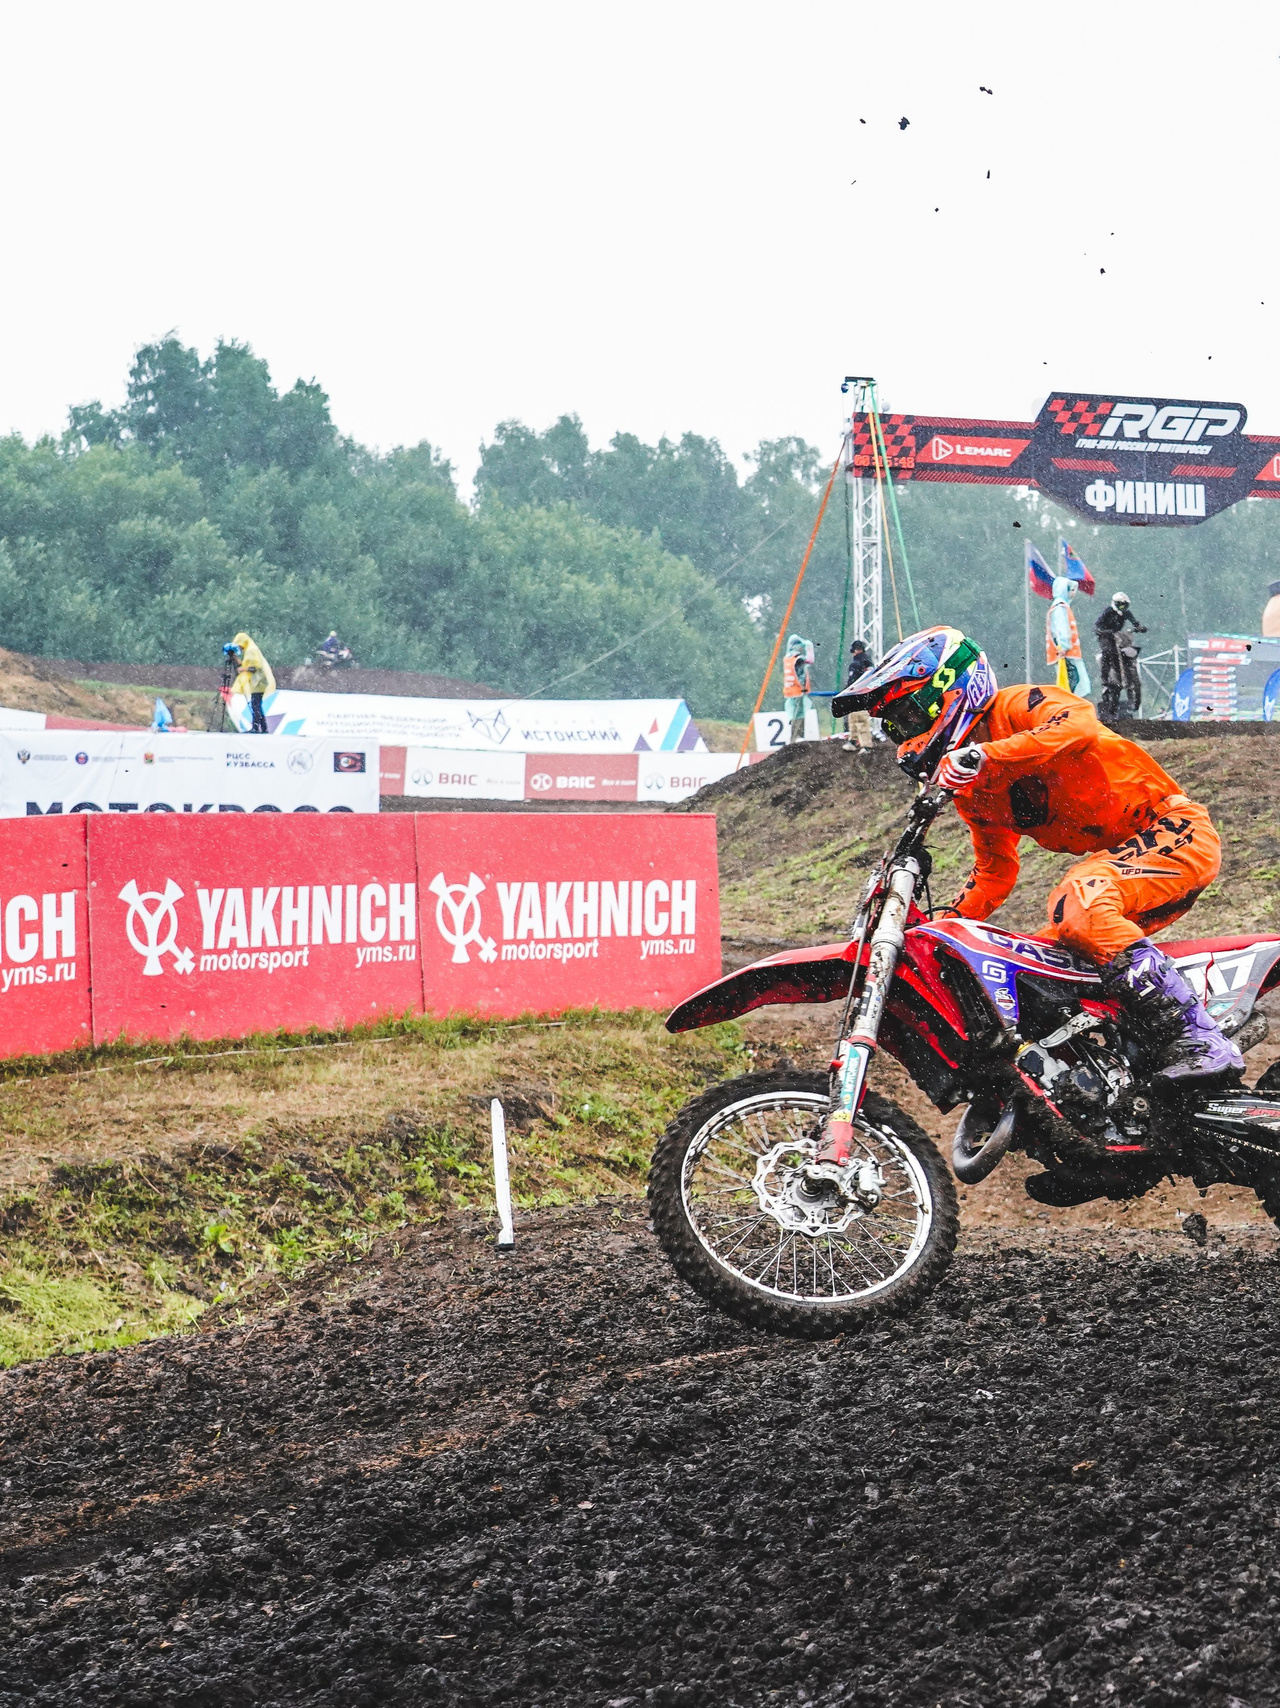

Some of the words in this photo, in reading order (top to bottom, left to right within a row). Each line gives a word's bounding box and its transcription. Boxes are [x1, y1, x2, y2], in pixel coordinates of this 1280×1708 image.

[1099, 402, 1243, 442] RGP
[955, 444, 1012, 458] LEMARC
[1085, 479, 1206, 517] ФИНИШ
[521, 727, 623, 742] ИСТОКСКИЙ
[226, 761, 275, 769] КУЗБАССА
[438, 772, 478, 786] BAIC
[555, 775, 596, 789] BAIC
[1121, 868, 1141, 876] UFO
[196, 881, 416, 950] YAKHNICH
[496, 879, 697, 940] YAKHNICH
[0, 892, 76, 963] CH
[199, 948, 310, 974] motorsport
[355, 945, 417, 968] yms.ru
[501, 938, 600, 964] motorsport
[639, 938, 696, 960] yms.ru
[1, 961, 76, 993] yms.ru
